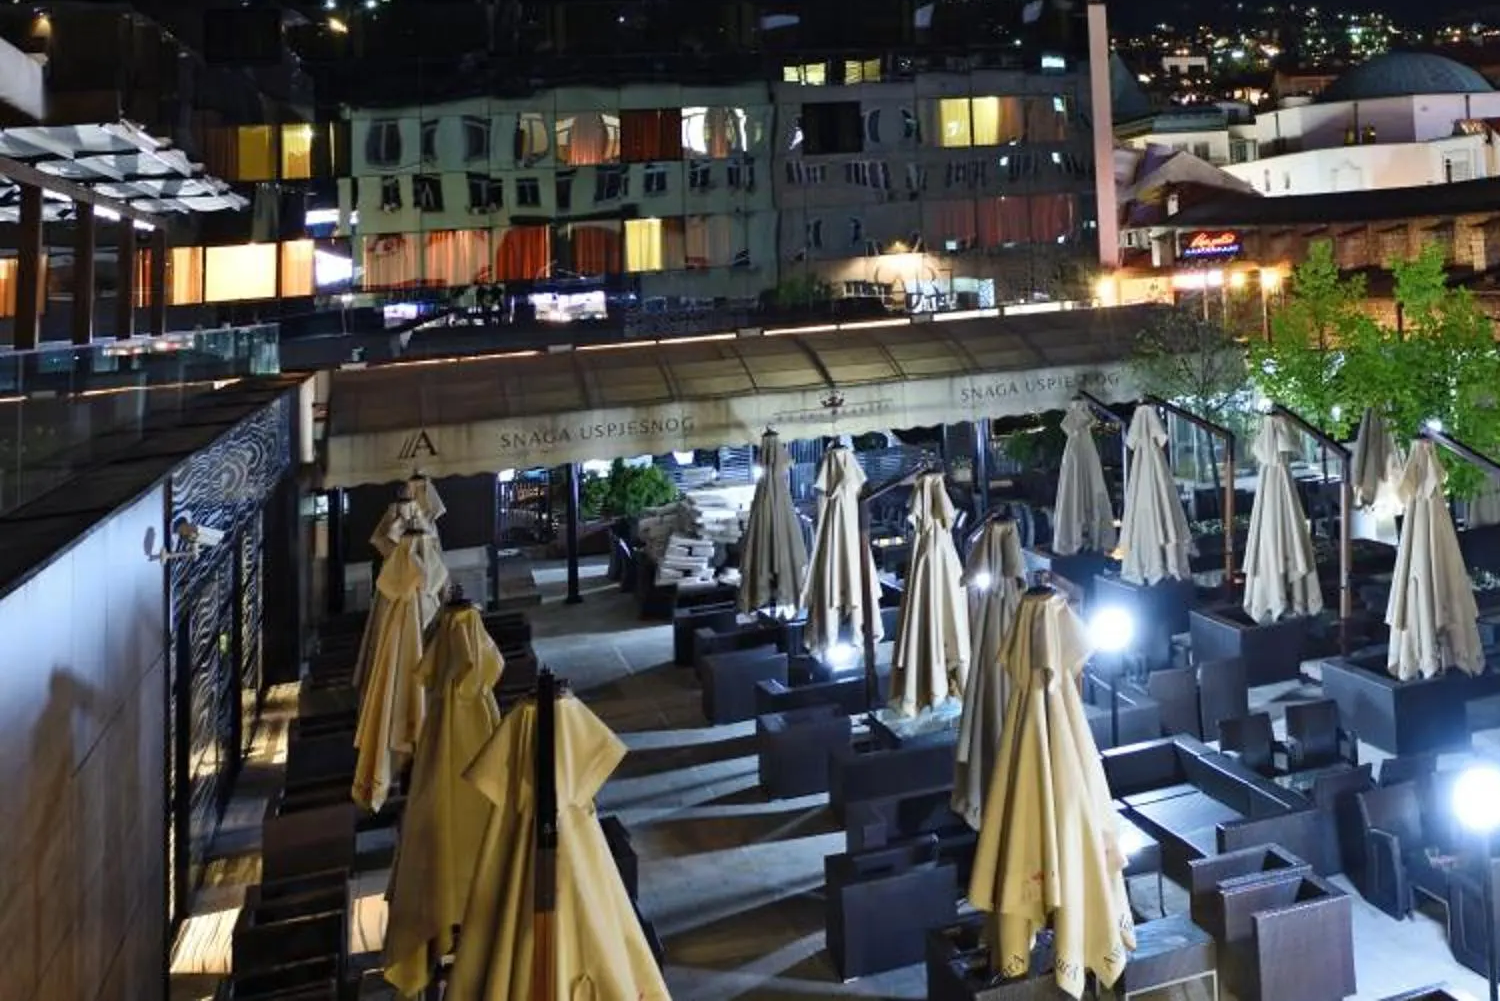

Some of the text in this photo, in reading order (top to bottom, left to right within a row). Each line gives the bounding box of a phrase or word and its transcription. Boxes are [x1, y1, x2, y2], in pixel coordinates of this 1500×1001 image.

[961, 380, 1019, 401] SNAGA
[500, 416, 695, 448] SNAGA USPJESNOG
